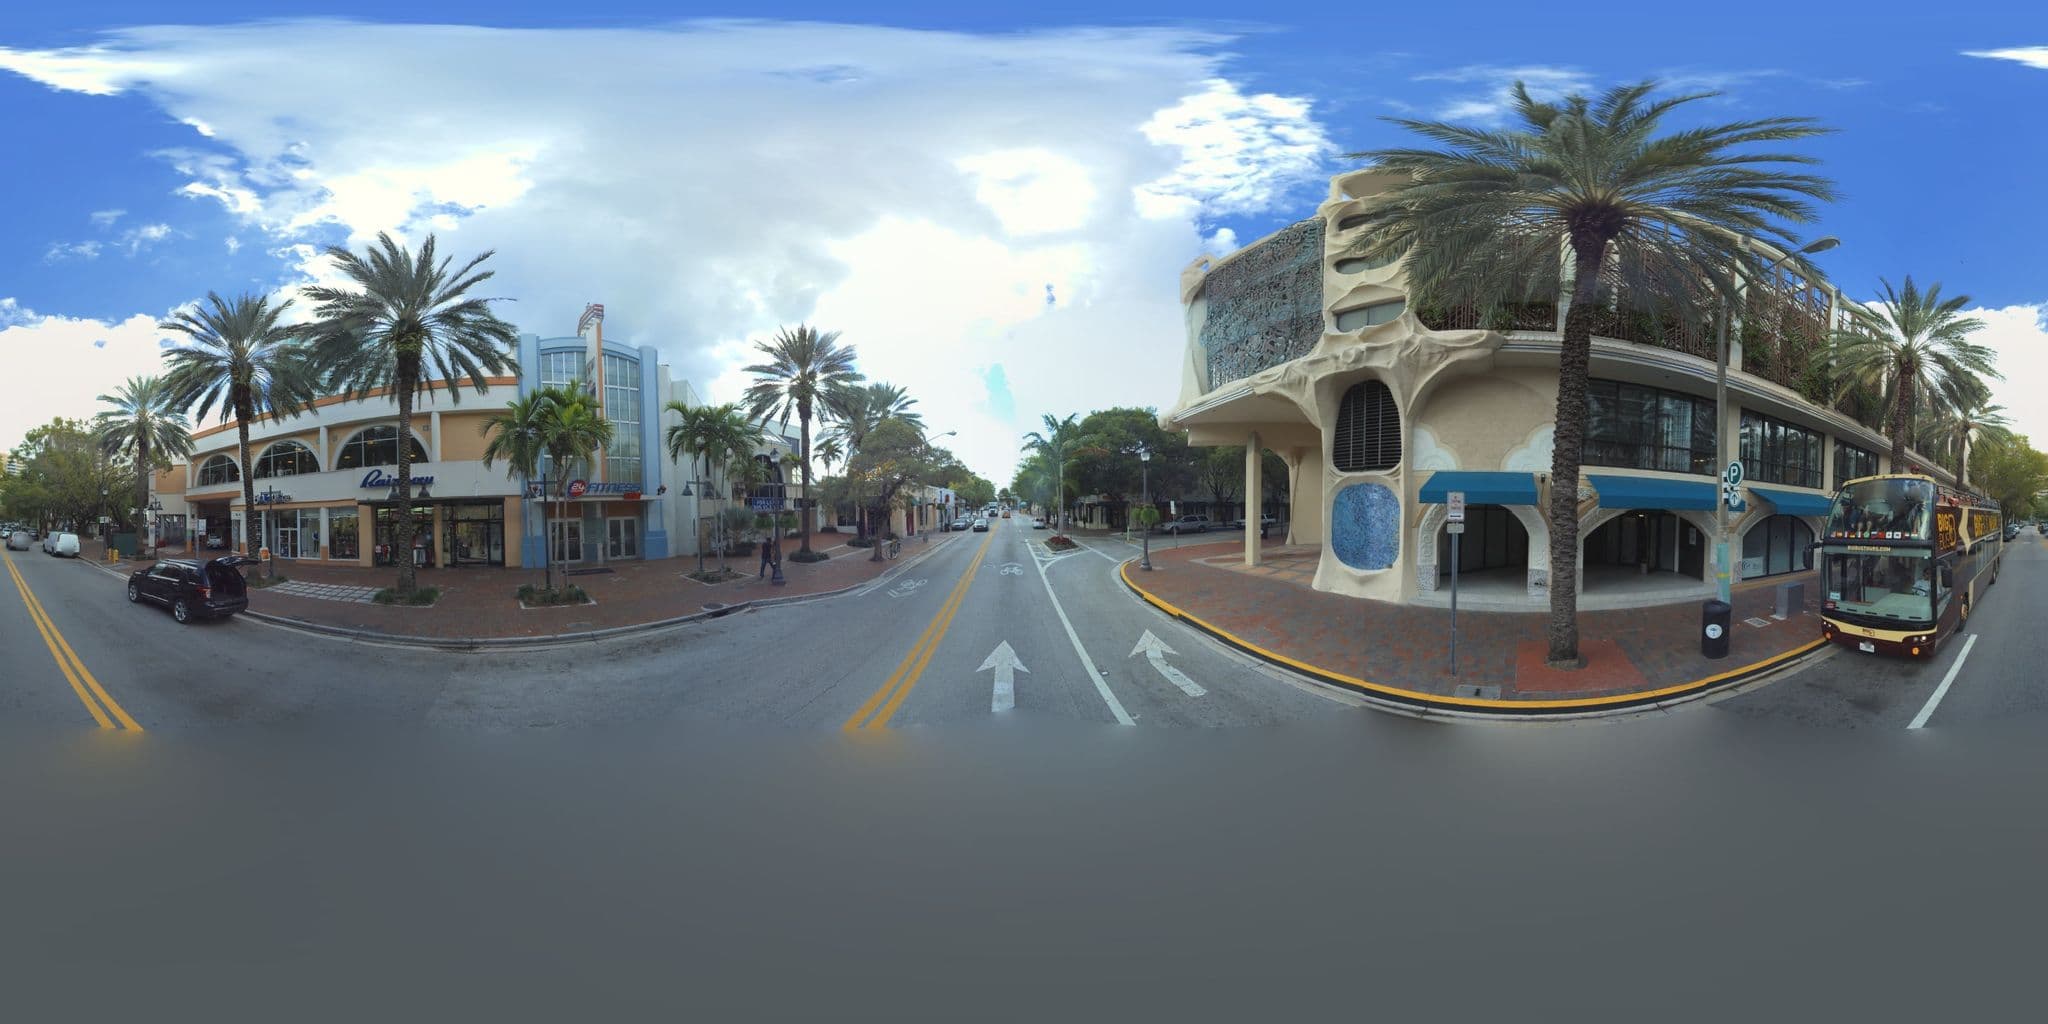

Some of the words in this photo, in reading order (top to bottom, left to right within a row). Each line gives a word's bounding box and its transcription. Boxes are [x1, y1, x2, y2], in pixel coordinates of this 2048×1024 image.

[1731, 466, 1738, 481] P
[587, 483, 641, 493] FITNESS
[1937, 513, 1950, 532] BIG
